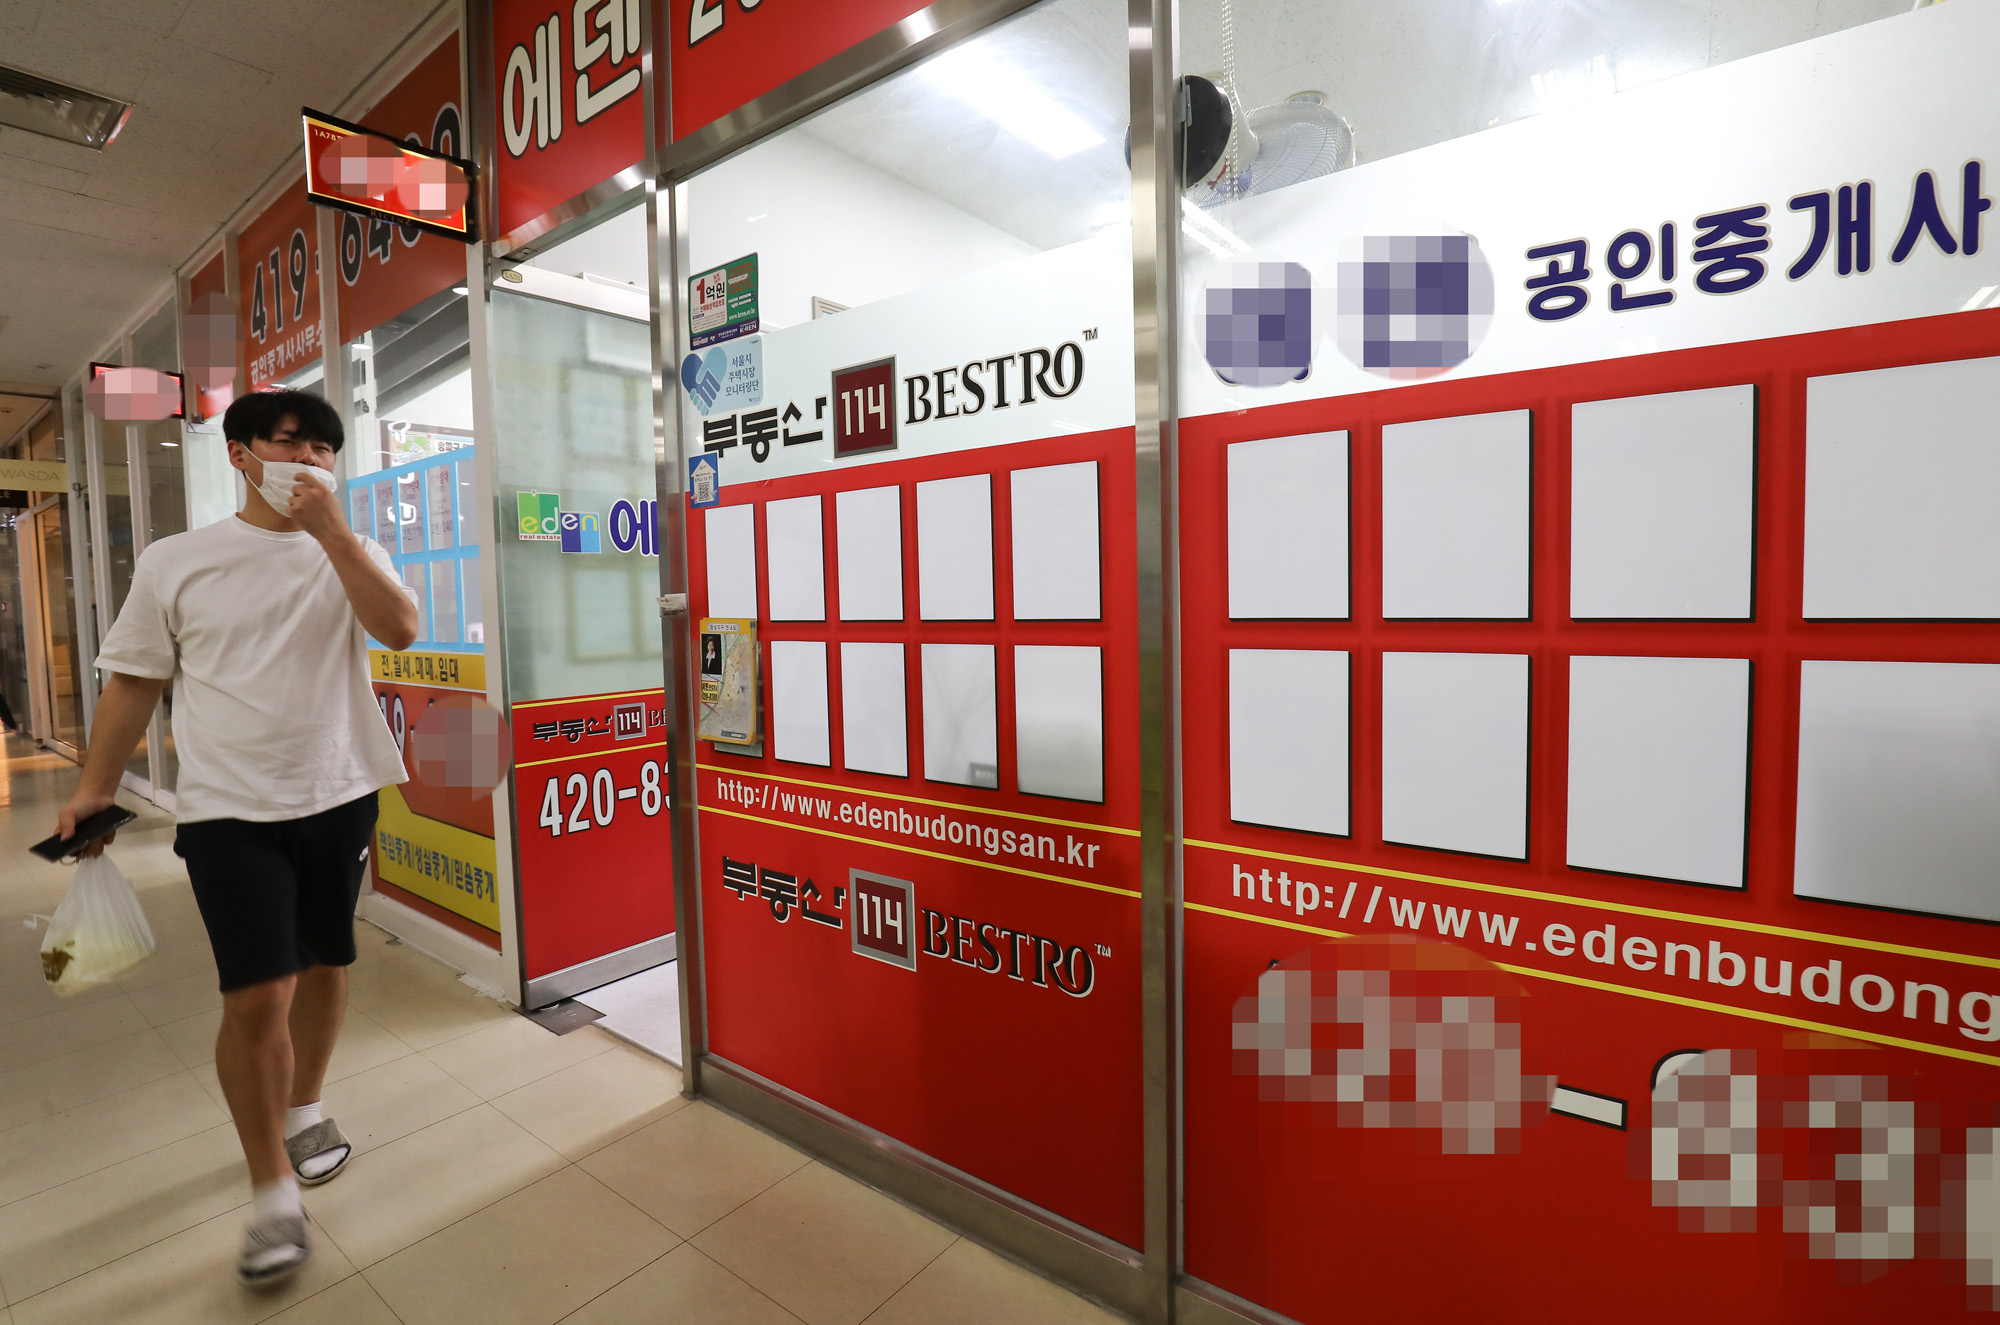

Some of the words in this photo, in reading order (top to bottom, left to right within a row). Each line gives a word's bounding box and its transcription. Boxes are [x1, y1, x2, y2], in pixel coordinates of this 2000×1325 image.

[502, 0, 643, 157] 에덴
[1524, 157, 1997, 323] 공인중개사
[725, 380, 760, 397] 모니터링단
[728, 366, 756, 383] 주택시장
[731, 352, 753, 368] 서울시
[702, 393, 828, 464] 부동산
[839, 382, 887, 437] 114
[904, 338, 1086, 426] BESTRO
[520, 506, 598, 534] eden
[533, 715, 613, 743] 부동산
[618, 711, 641, 732] 114
[717, 777, 1100, 869] http://www.edenbudongsan.kr
[722, 855, 847, 929] 부동산
[858, 891, 904, 946] 114
[921, 906, 1096, 998] BESTRO
